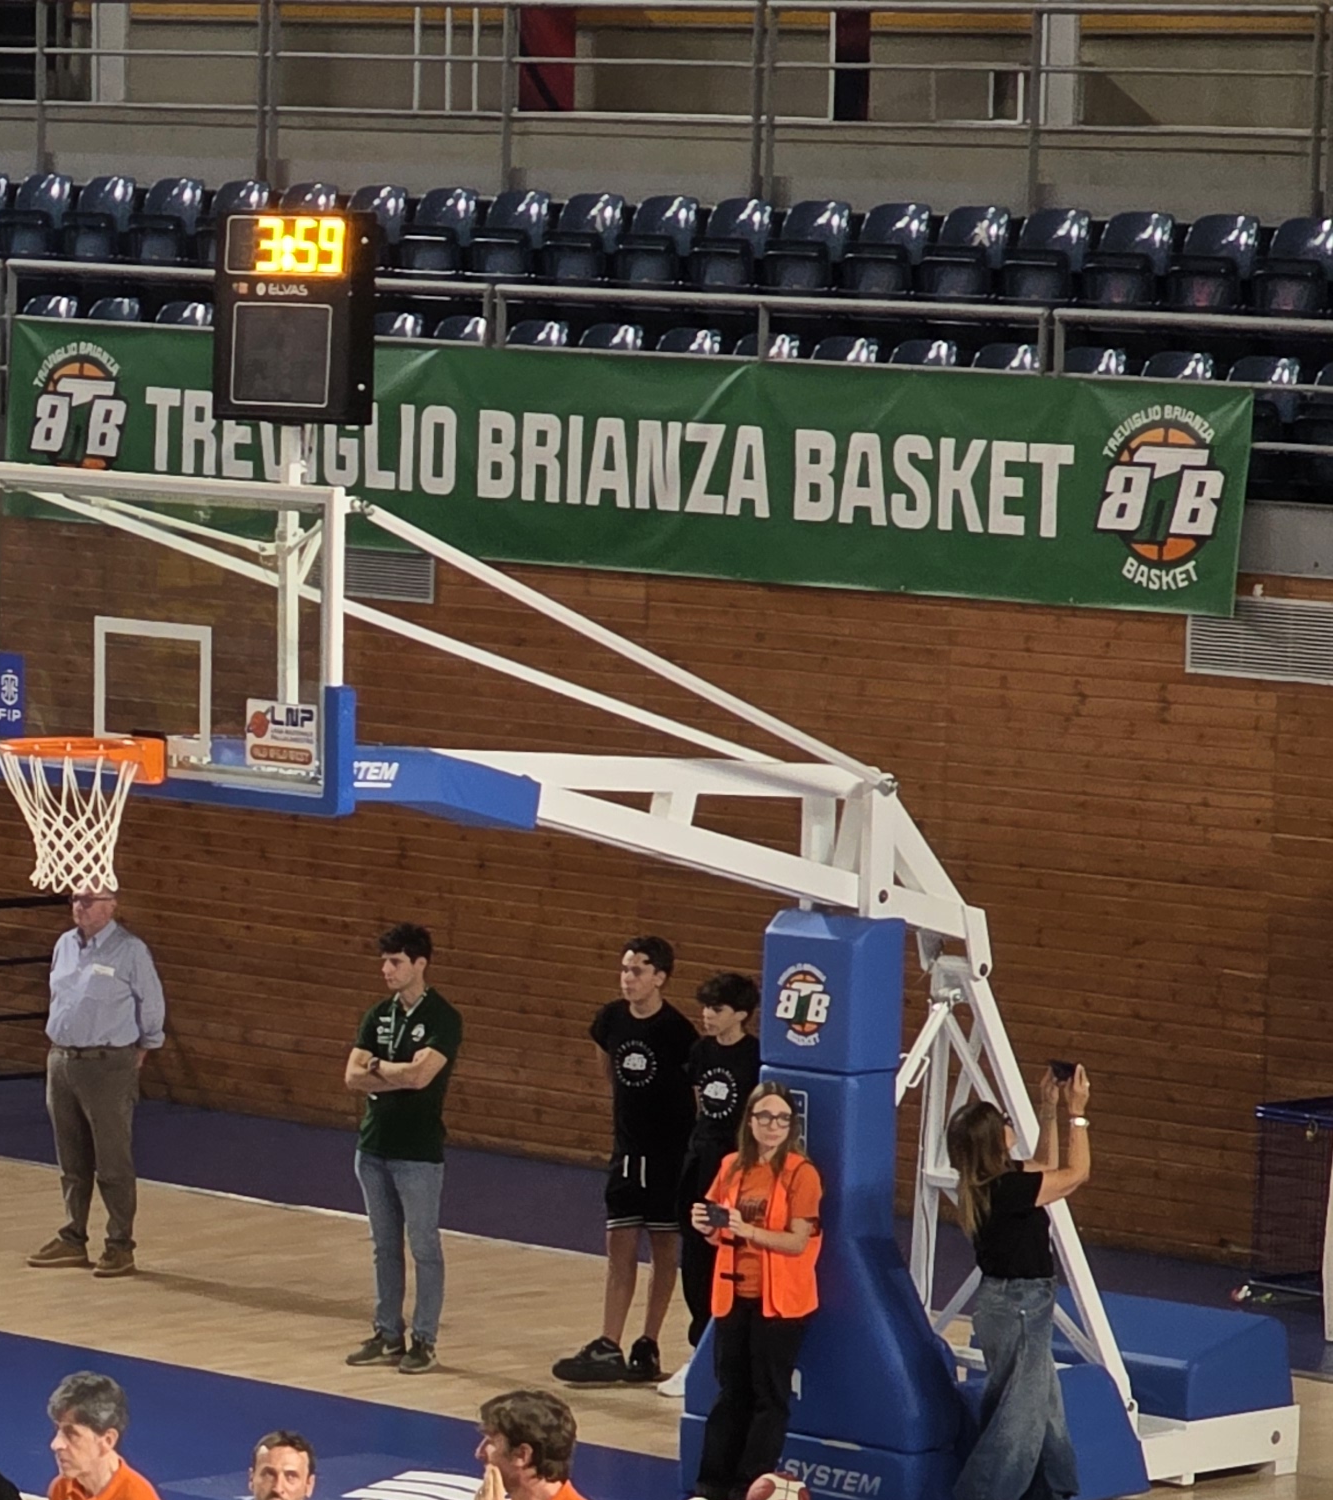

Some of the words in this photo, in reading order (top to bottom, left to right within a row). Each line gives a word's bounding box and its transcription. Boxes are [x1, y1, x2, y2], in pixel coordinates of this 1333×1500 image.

[1102, 404, 1162, 459] TREVIGLIO
[476, 407, 771, 519] BRIANZA
[792, 427, 1076, 539] BASKET
[1120, 555, 1200, 592] BASKET
[269, 705, 315, 729] LNP
